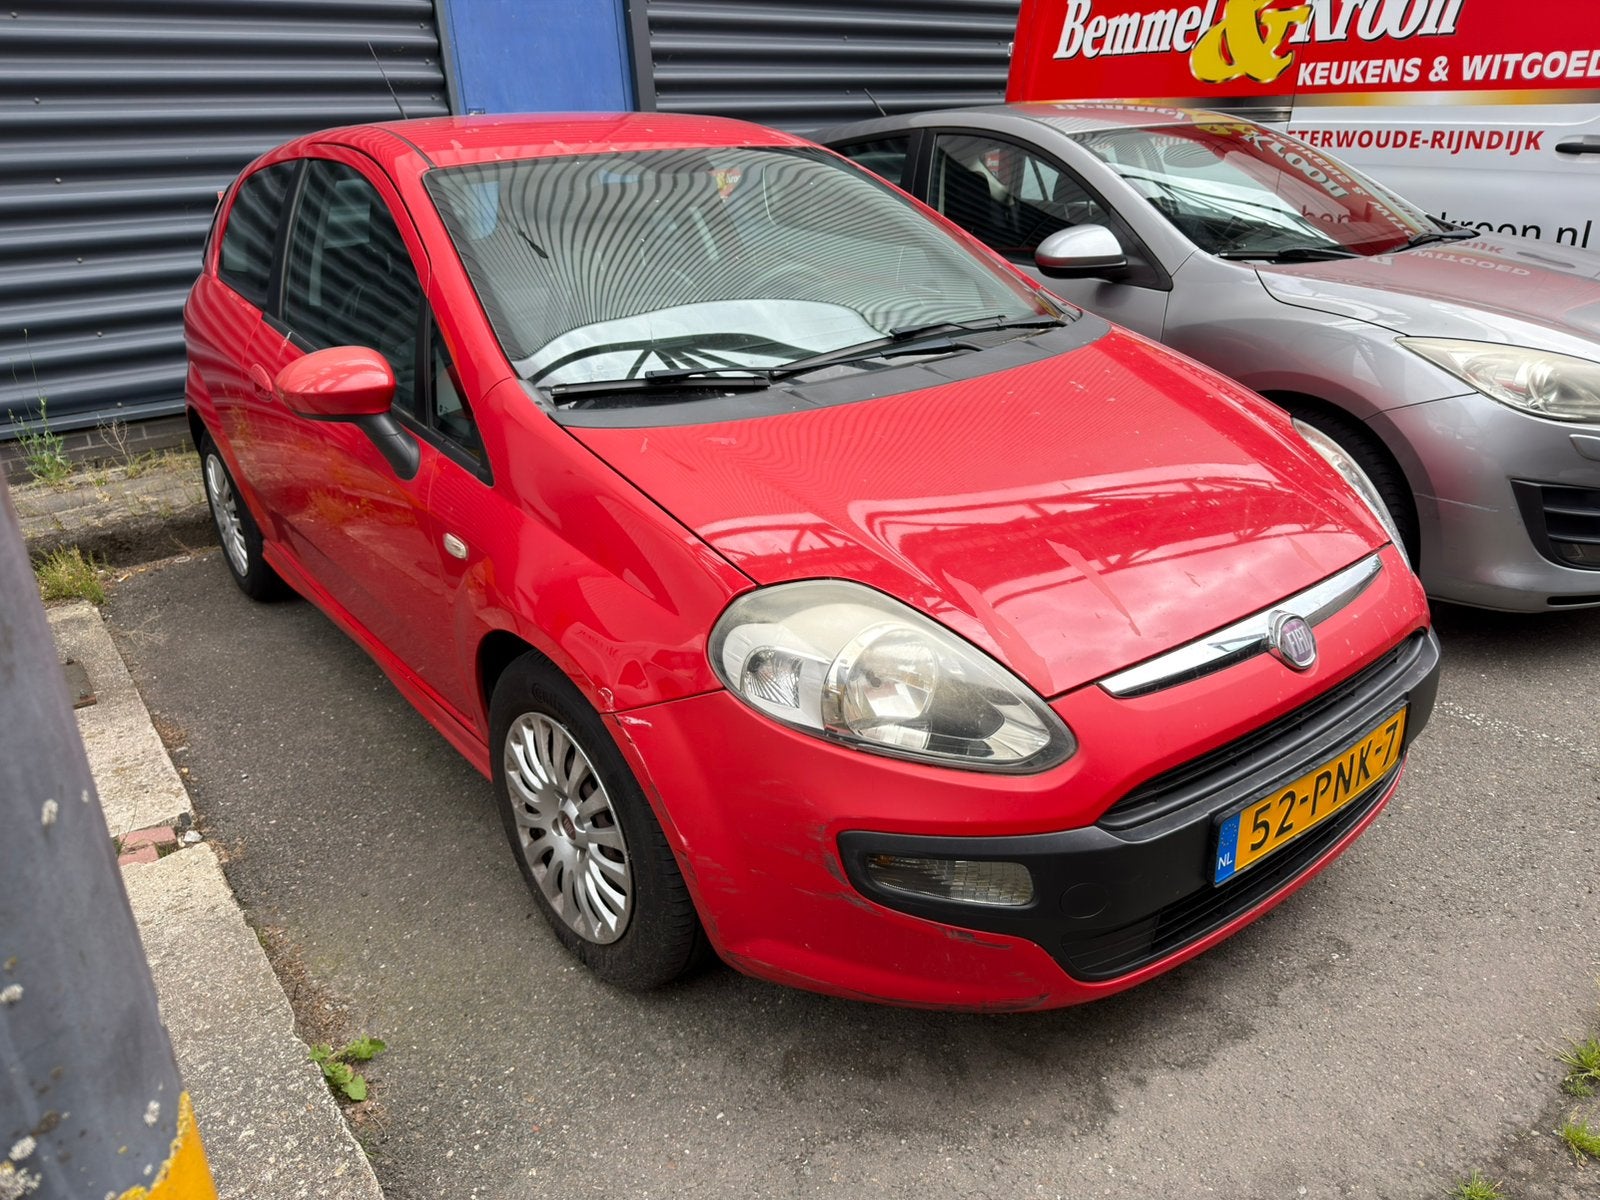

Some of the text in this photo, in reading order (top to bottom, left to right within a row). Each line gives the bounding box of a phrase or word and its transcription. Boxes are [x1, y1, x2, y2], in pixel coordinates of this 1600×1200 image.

[1053, 0, 1218, 59] Bemmel
[1189, 0, 1312, 84] &
[1297, 57, 1421, 86] KEUKENS
[1428, 55, 1450, 83] &
[1287, 130, 1545, 155] TERWOUDE-RIJNDIJK
[1285, 625, 1312, 659] FIAT
[1249, 719, 1400, 852] 52-PNK-7
[1217, 853, 1233, 871] NL
